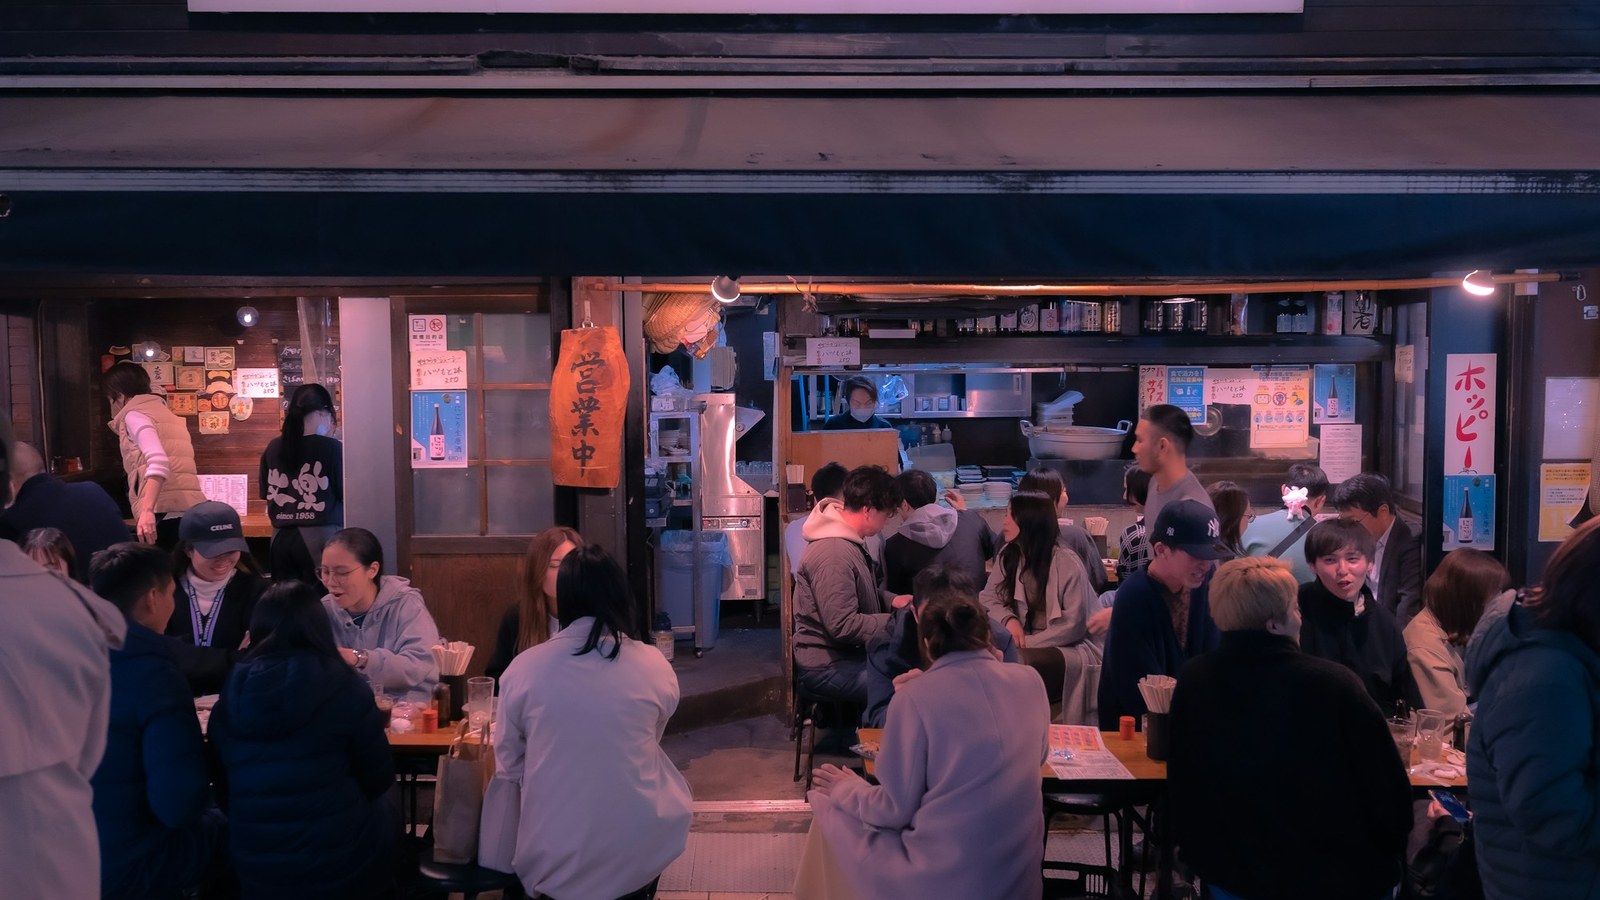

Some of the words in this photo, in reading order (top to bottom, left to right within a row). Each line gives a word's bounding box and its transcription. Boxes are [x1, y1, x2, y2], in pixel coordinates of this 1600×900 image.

[570, 351, 605, 478] 営業中
[1455, 360, 1489, 469] ホッピー
[276, 512, 294, 520] since
[295, 512, 315, 520] 1958
[210, 523, 233, 532] CELINE
[1207, 517, 1220, 538] NY
